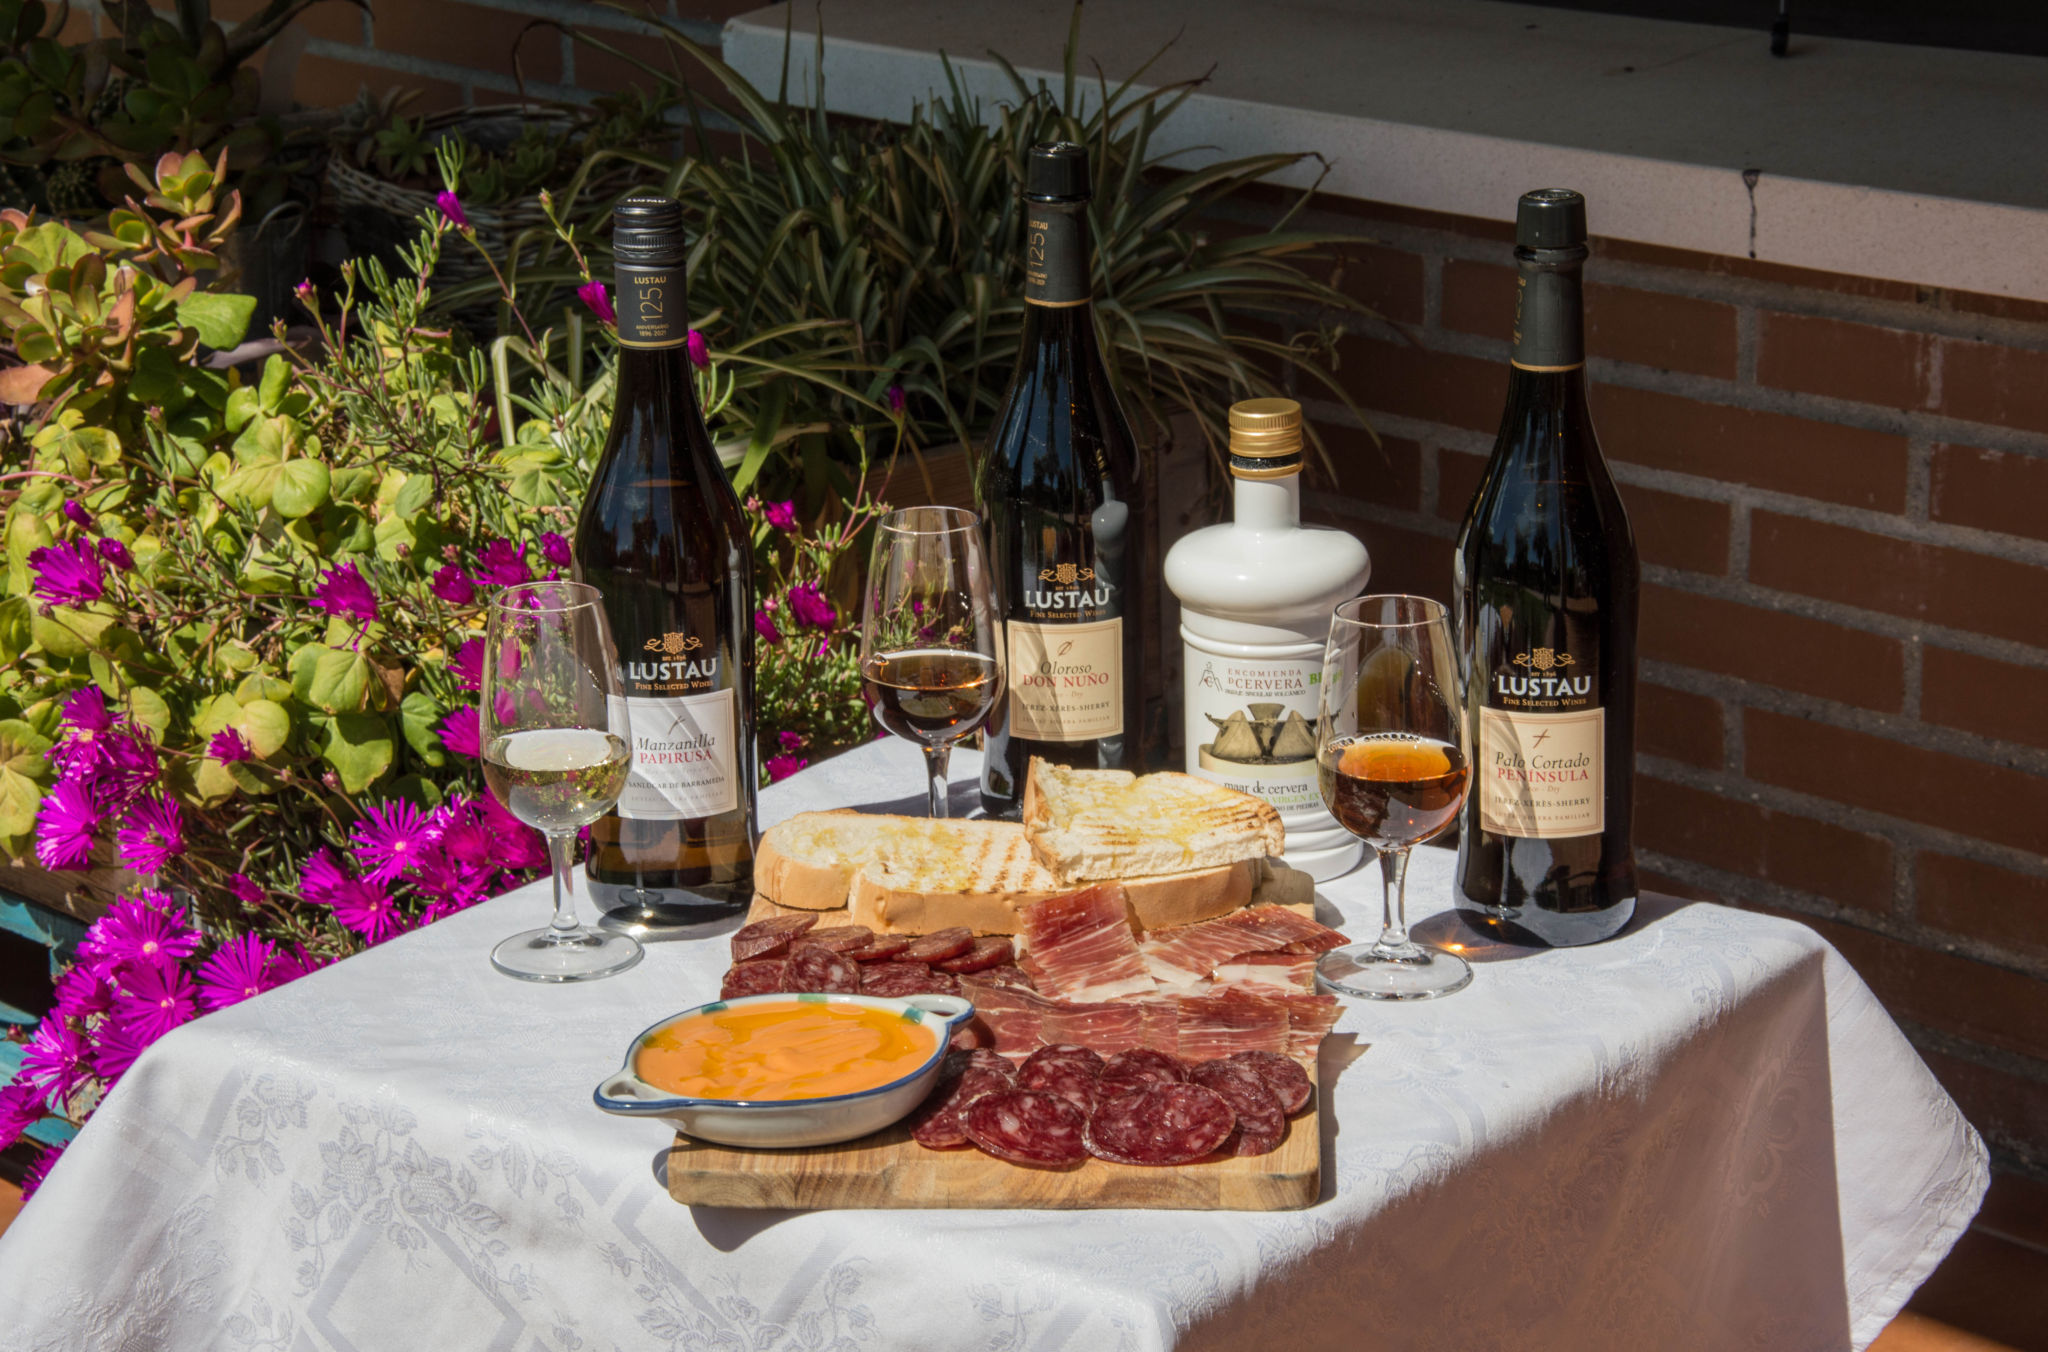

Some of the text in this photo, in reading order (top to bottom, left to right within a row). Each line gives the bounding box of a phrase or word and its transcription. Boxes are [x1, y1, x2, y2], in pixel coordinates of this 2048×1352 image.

[634, 276, 667, 285] LUSTAU
[640, 287, 663, 321] 125
[1024, 587, 1110, 609] LUSTAU
[628, 657, 718, 681] LUSTAU
[1040, 660, 1092, 676] Oloroso
[1228, 667, 1303, 678] ENCOMIENDA
[1023, 671, 1109, 688] DON NUÑO
[1498, 675, 1591, 697] LUSTAU
[1521, 698, 1560, 707] SELECTED
[636, 733, 716, 751] Manzanilla
[639, 748, 713, 765] PAPIRUSA
[1495, 751, 1591, 770] Palo Cortado
[1497, 767, 1590, 783] PENÍNSULA
[1252, 780, 1265, 794] de
[1268, 783, 1308, 795] cervera
